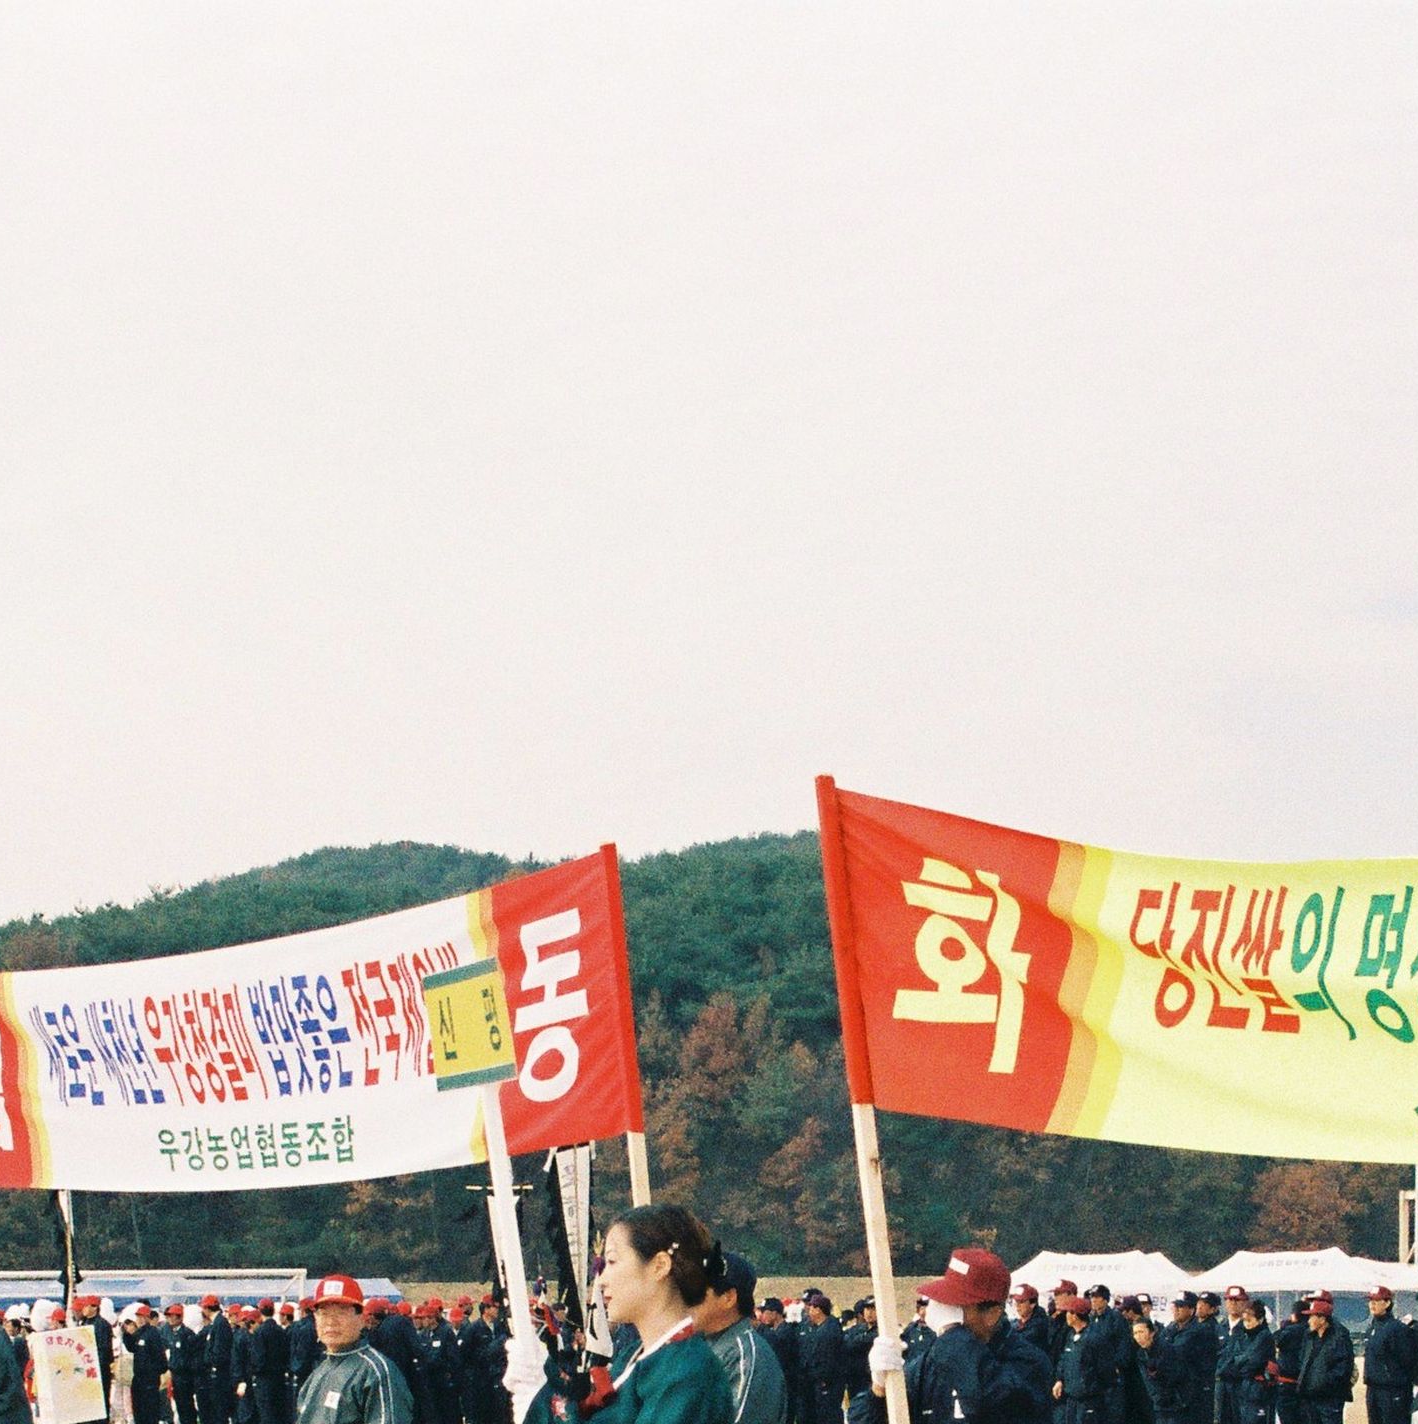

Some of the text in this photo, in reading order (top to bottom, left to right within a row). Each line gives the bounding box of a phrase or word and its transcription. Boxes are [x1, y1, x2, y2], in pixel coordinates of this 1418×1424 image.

[143, 983, 270, 1107] 우강청결미
[247, 973, 356, 1096] 밥맛좋은
[513, 907, 590, 1102] 동
[892, 856, 1033, 1075] 화
[1128, 881, 1357, 1042] 당진쌀의
[157, 1115, 355, 1171] 우강농업협동조합
